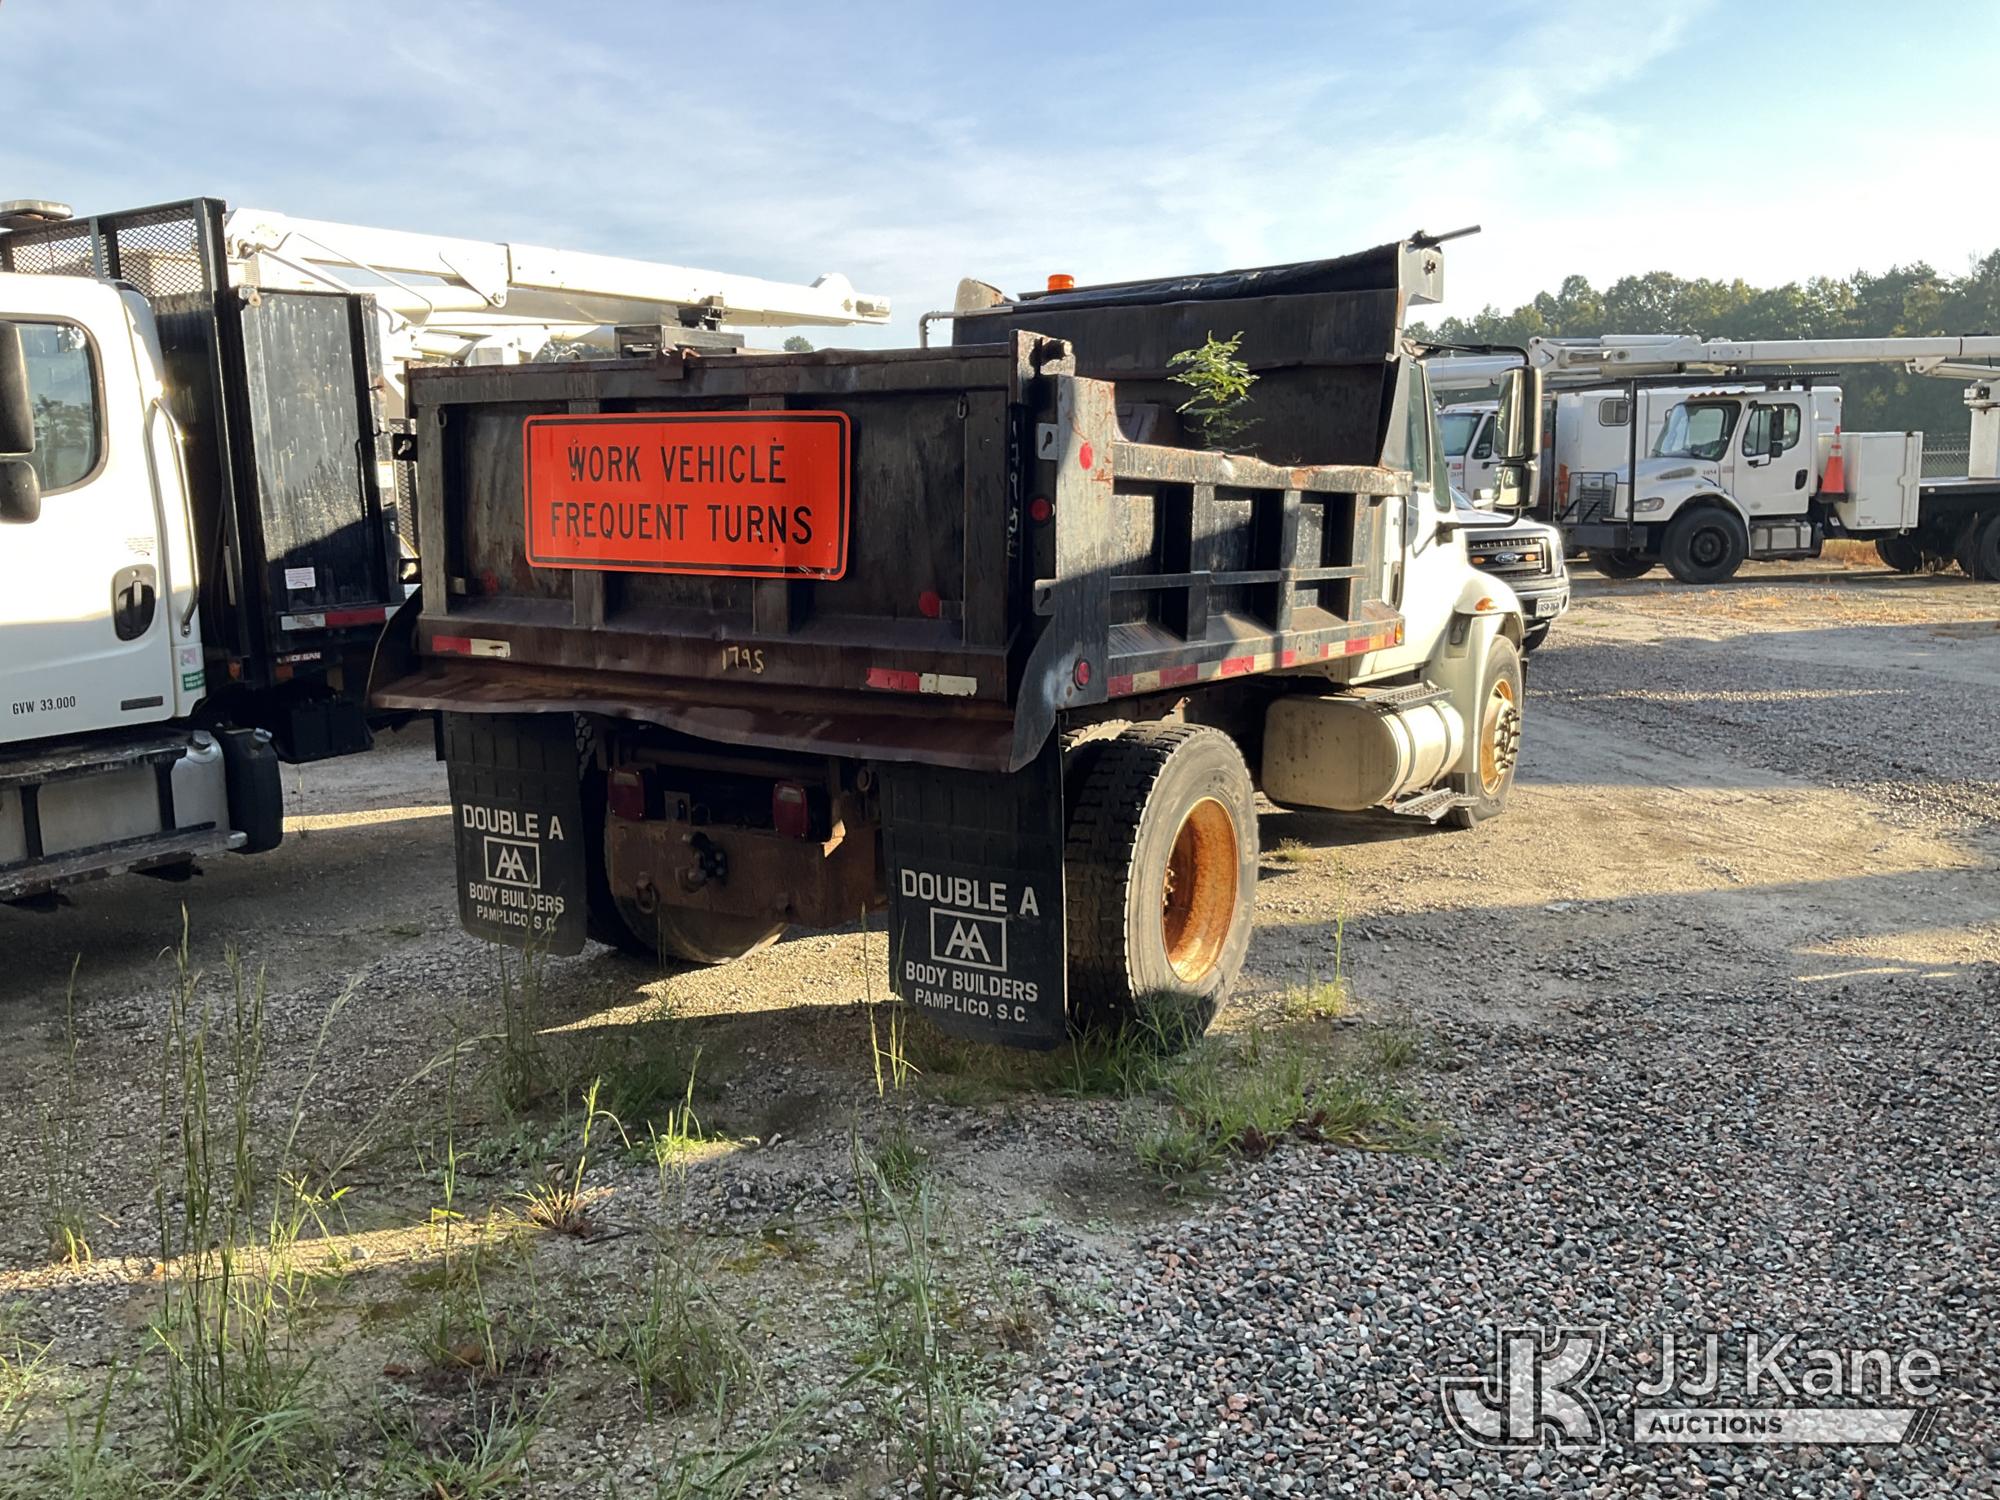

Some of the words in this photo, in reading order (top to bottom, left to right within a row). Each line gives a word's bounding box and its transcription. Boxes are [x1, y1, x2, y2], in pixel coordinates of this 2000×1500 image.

[567, 445, 641, 482] WORK
[660, 444, 786, 483] VEHICLE
[551, 502, 689, 541] FREQUENT
[707, 504, 813, 545] TURNS
[722, 645, 765, 674] 1795
[12, 701, 35, 715] GVW
[40, 695, 76, 711] 33.000
[462, 803, 540, 838] DOUBLE
[548, 815, 564, 841] A
[469, 882, 498, 904] BODY
[501, 888, 565, 914] BUILDERS
[901, 868, 1008, 913] DOUBLE
[1019, 886, 1040, 917] A
[905, 960, 947, 988] BODY
[952, 970, 1039, 1003] BUILDERS
[915, 987, 993, 1020] PAMPLICO,
